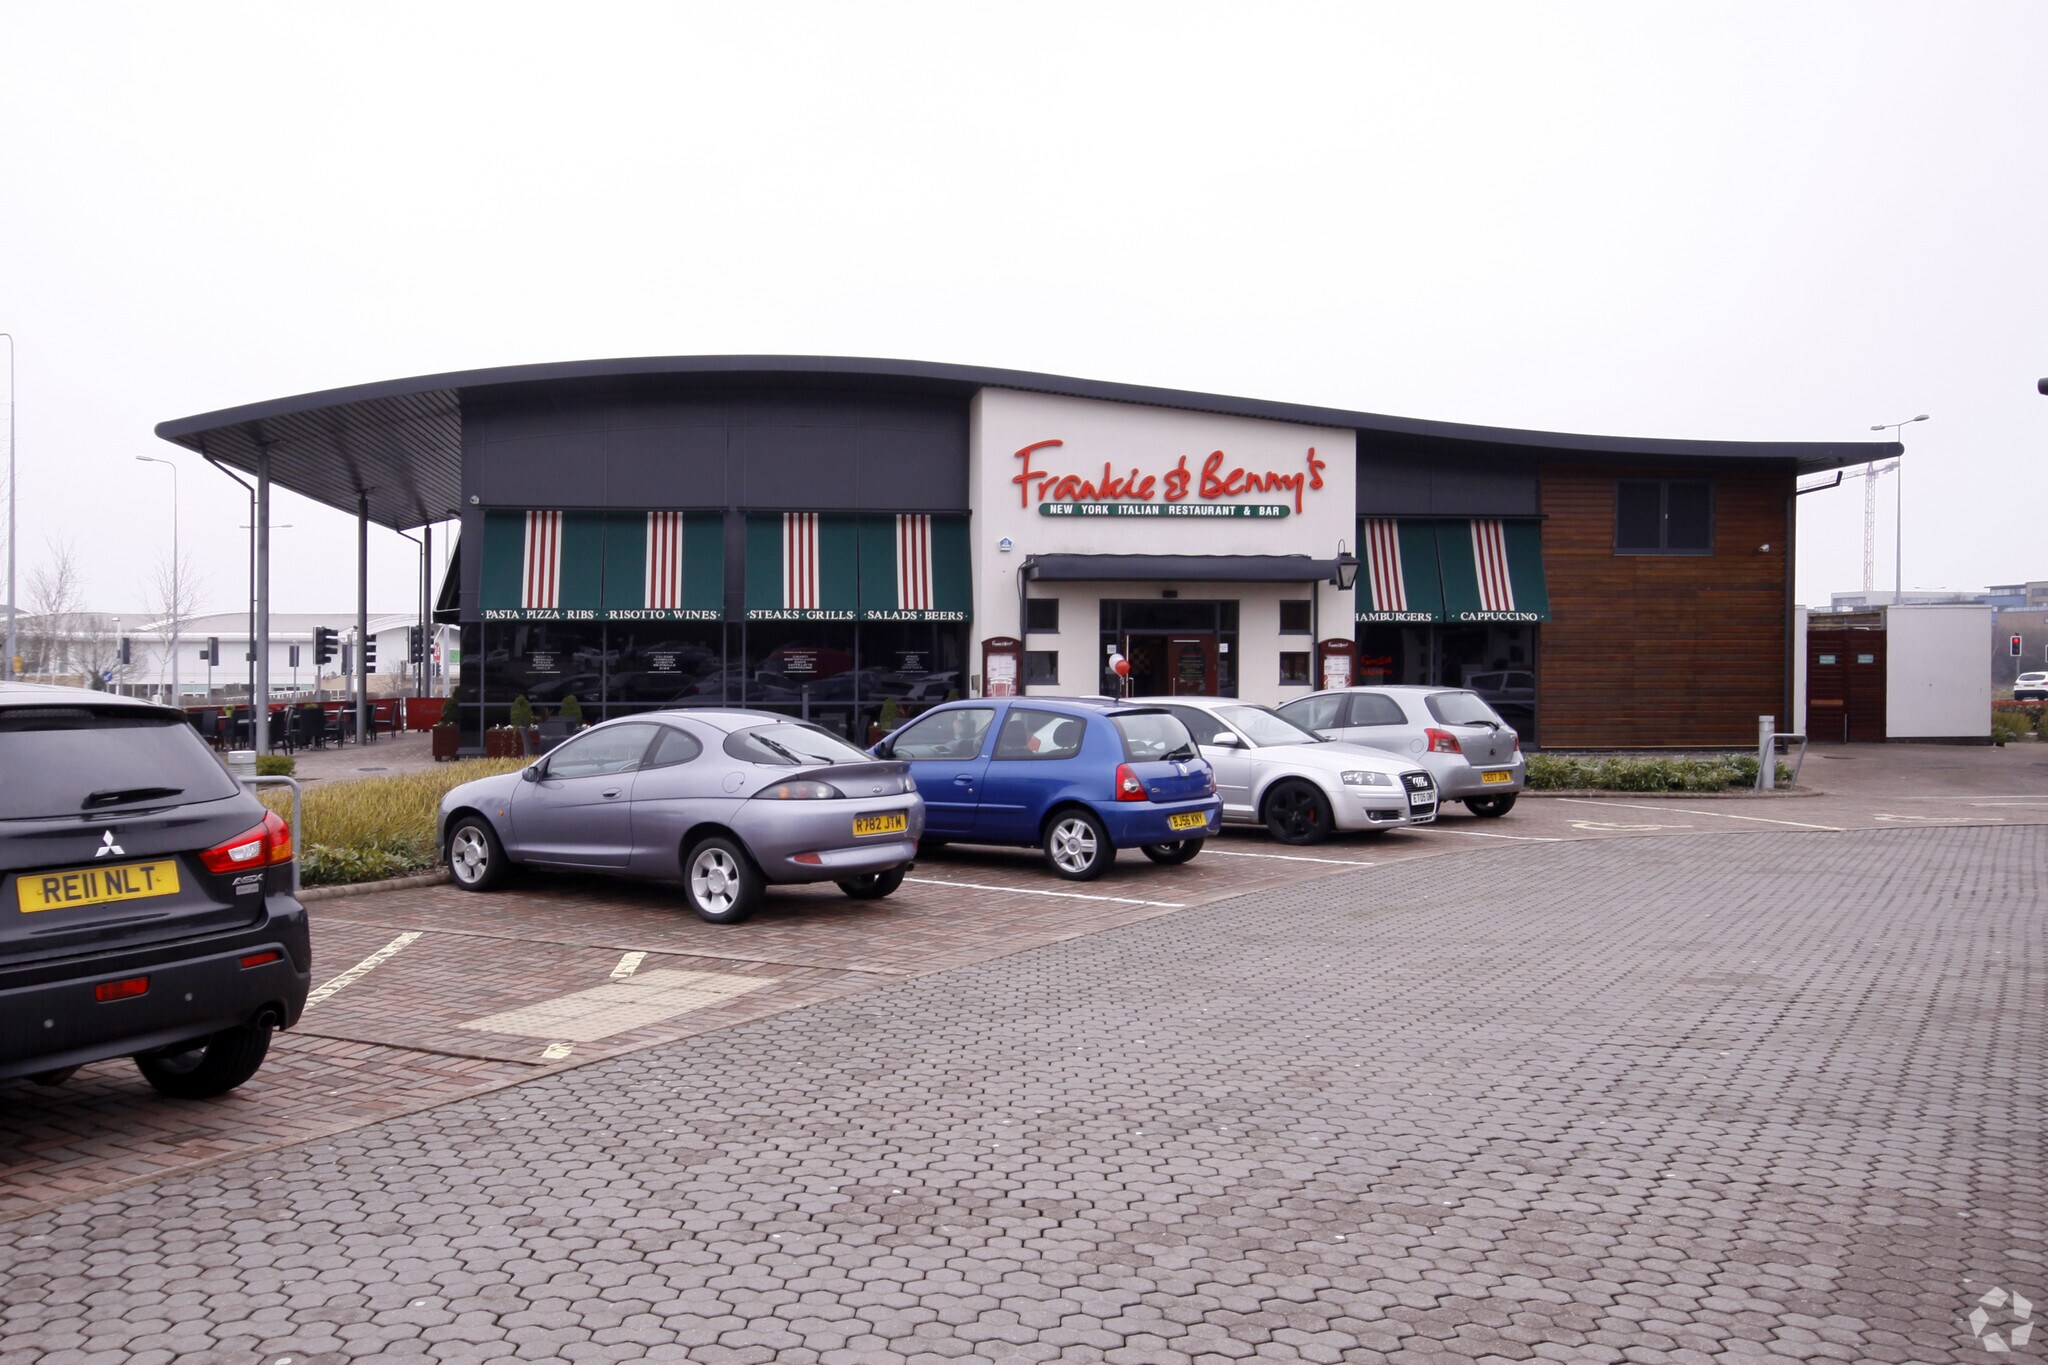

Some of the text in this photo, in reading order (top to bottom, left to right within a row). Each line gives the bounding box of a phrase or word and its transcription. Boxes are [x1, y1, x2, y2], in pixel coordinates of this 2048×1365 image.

[1012, 439, 1326, 514] Frankie & Benny's
[1050, 504, 1280, 516] NEW YORK ITALIAN RESTAURANT & BAR
[485, 610, 595, 620] PASTA PIZZA RIBS
[609, 610, 718, 620] RISOTTO WINES
[749, 610, 854, 620] STEAKS GRILLS
[867, 610, 964, 621] SALADS BEERS
[1354, 612, 1432, 622] HAMBURGERS
[1460, 612, 1538, 621] CAPPUCCINO
[856, 815, 902, 832] R782 JTM
[42, 866, 155, 904] RE11 NLT
[232, 873, 263, 886] ASX
